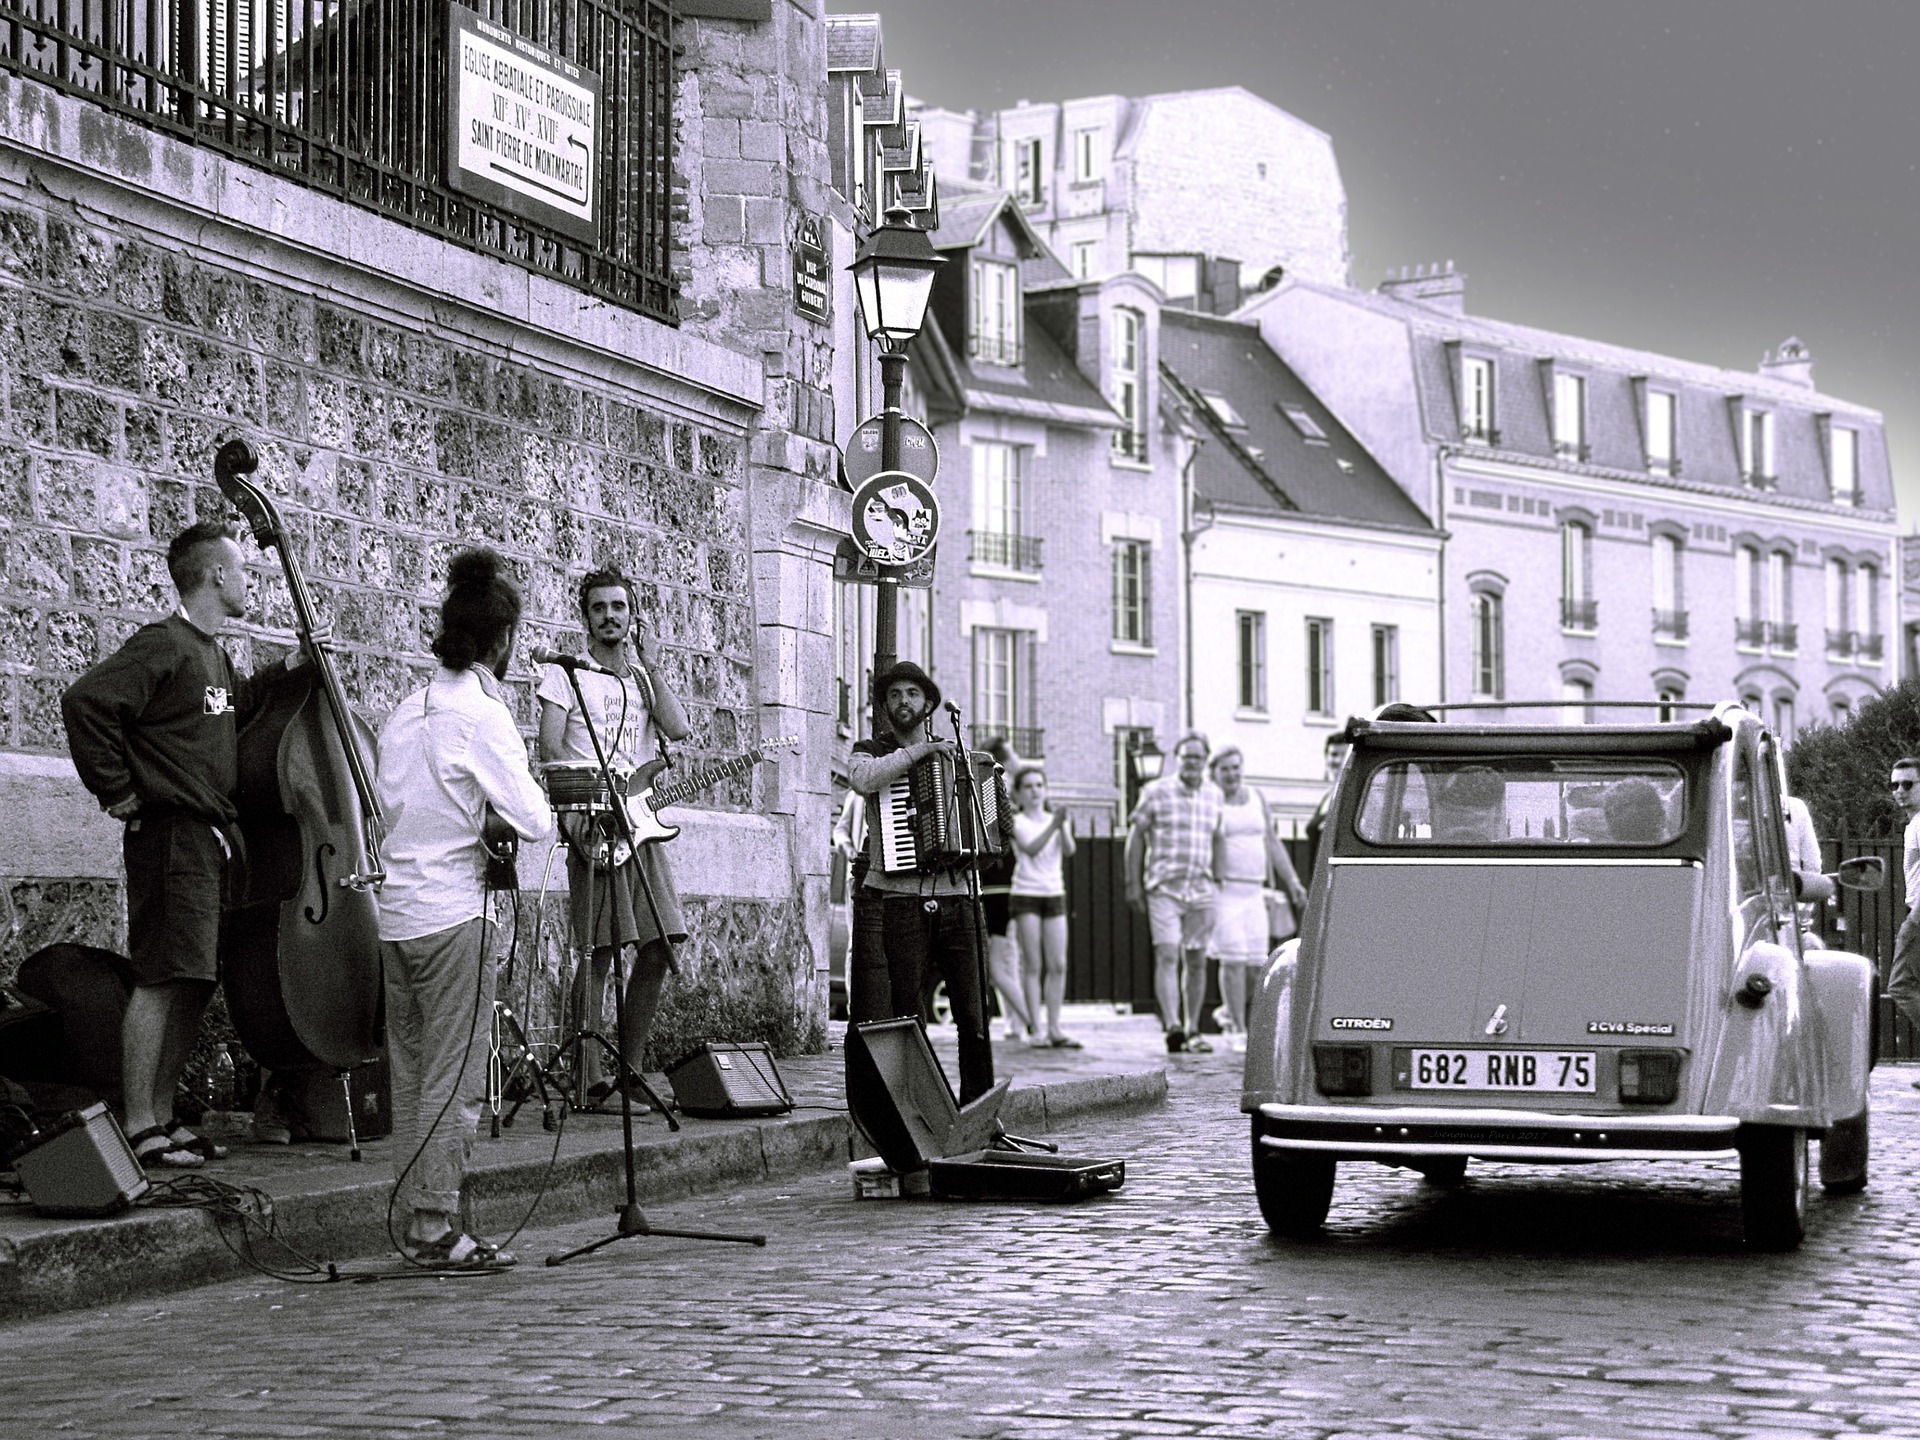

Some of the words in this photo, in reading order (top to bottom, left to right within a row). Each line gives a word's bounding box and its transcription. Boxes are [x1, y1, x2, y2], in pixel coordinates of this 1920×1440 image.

[477, 19, 512, 46] MONUMENTS
[514, 38, 551, 65] HISTORIQUES
[554, 56, 561, 70] ET
[564, 62, 580, 80] SITES
[493, 59, 534, 101] ABBATIALE
[535, 79, 544, 105] ET
[546, 83, 591, 128] PAROISSIALE
[471, 118, 494, 152] SAINT
[496, 128, 521, 164] PIERRE
[523, 141, 533, 169] DE
[535, 146, 583, 191] MONTMARTRE
[805, 259, 818, 276] RUE
[796, 271, 804, 286] DU
[804, 274, 828, 296] CARDINAL
[801, 289, 824, 310] GUIBERT
[605, 712, 638, 724] pouser
[1626, 1022, 1674, 1035] Special
[1418, 1053, 1467, 1084] 682
[1487, 1054, 1536, 1086] RNB
[1558, 1056, 1589, 1087] 75
